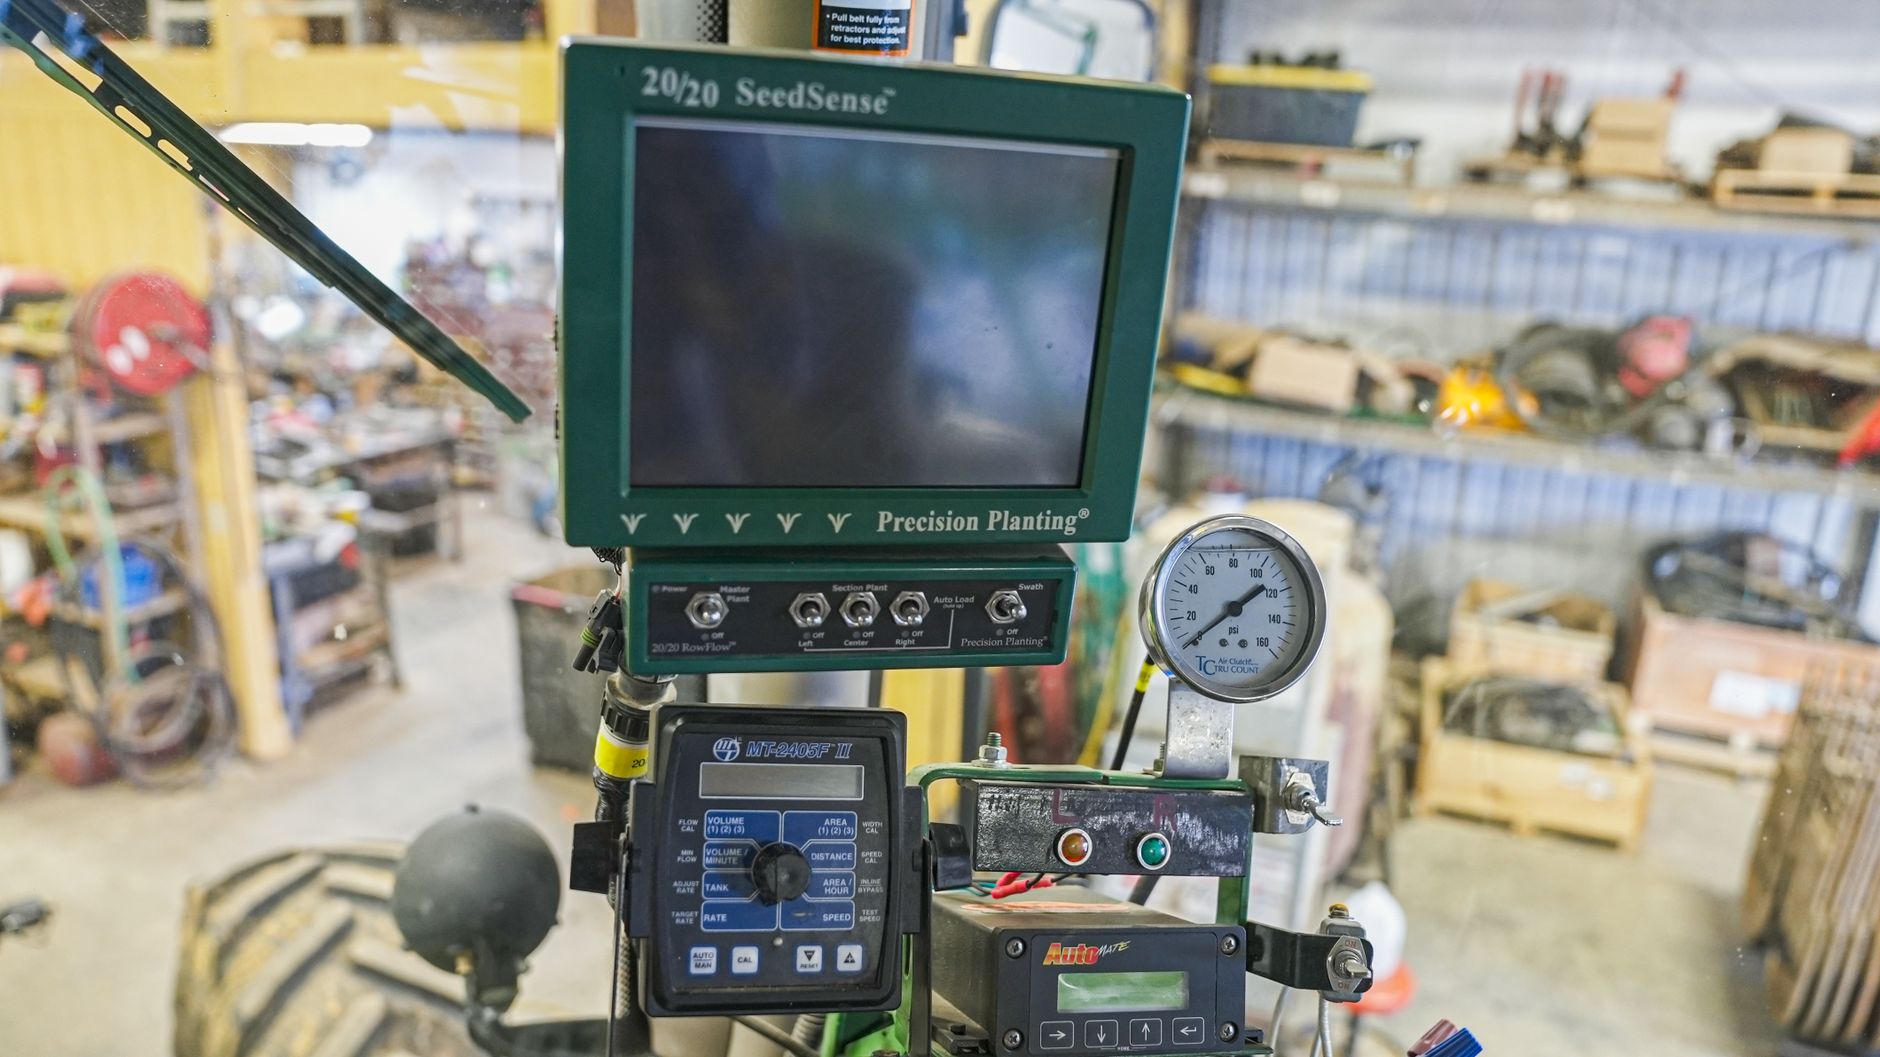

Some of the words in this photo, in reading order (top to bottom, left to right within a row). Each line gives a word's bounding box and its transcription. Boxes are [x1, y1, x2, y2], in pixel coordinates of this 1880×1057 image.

[831, 13, 848, 22] Pull
[849, 15, 864, 23] belt
[866, 15, 882, 25] fully
[884, 15, 900, 24] from
[831, 25, 870, 34] retractors
[887, 27, 906, 36] adjust
[830, 34, 841, 42] for
[843, 35, 861, 44] best
[641, 66, 720, 109] 20/20
[876, 510, 979, 532] Precision
[1228, 558, 1239, 569] 80
[1205, 566, 1215, 576] 60
[1250, 568, 1263, 578] 100
[720, 585, 751, 593] Master
[832, 584, 864, 592] Section
[865, 584, 888, 592] Plant
[1018, 583, 1044, 591] Swath
[1188, 585, 1199, 595] 40
[1265, 588, 1278, 599] 120
[933, 595, 953, 603] Auto
[955, 595, 975, 603] Load
[1186, 611, 1197, 621] 20
[1268, 614, 1281, 625] 140
[1006, 628, 1019, 636] Off
[1228, 625, 1239, 636] psi
[711, 631, 725, 639] Off
[843, 639, 869, 647] Center
[895, 638, 915, 647] Right
[961, 637, 1003, 647] Precision
[1256, 637, 1269, 648] 160
[1214, 665, 1229, 673] TRU
[1230, 665, 1259, 673] COUNT
[707, 817, 745, 825] VOLUME
[824, 818, 848, 826] AREA
[707, 826, 719, 834] (1)
[720, 826, 732, 834] (2)
[733, 826, 745, 834] (3)
[818, 827, 830, 836] (1)
[830, 827, 842, 836] (2)
[843, 827, 854, 836] (3)
[865, 826, 879, 834] CAL
[705, 848, 743, 856] VOLUME
[811, 852, 853, 861] DISTANCE
[672, 880, 700, 888] ADJUST
[822, 878, 846, 886] AREA
[705, 883, 729, 891] TANK
[824, 887, 849, 895] HOUR
[671, 910, 699, 918] TARGET
[703, 913, 728, 922] RATE
[822, 913, 851, 922] SPEED
[675, 917, 695, 925] RATE
[692, 952, 715, 960] AUTO
[737, 956, 753, 964] CAL
[694, 961, 713, 969] MAN
